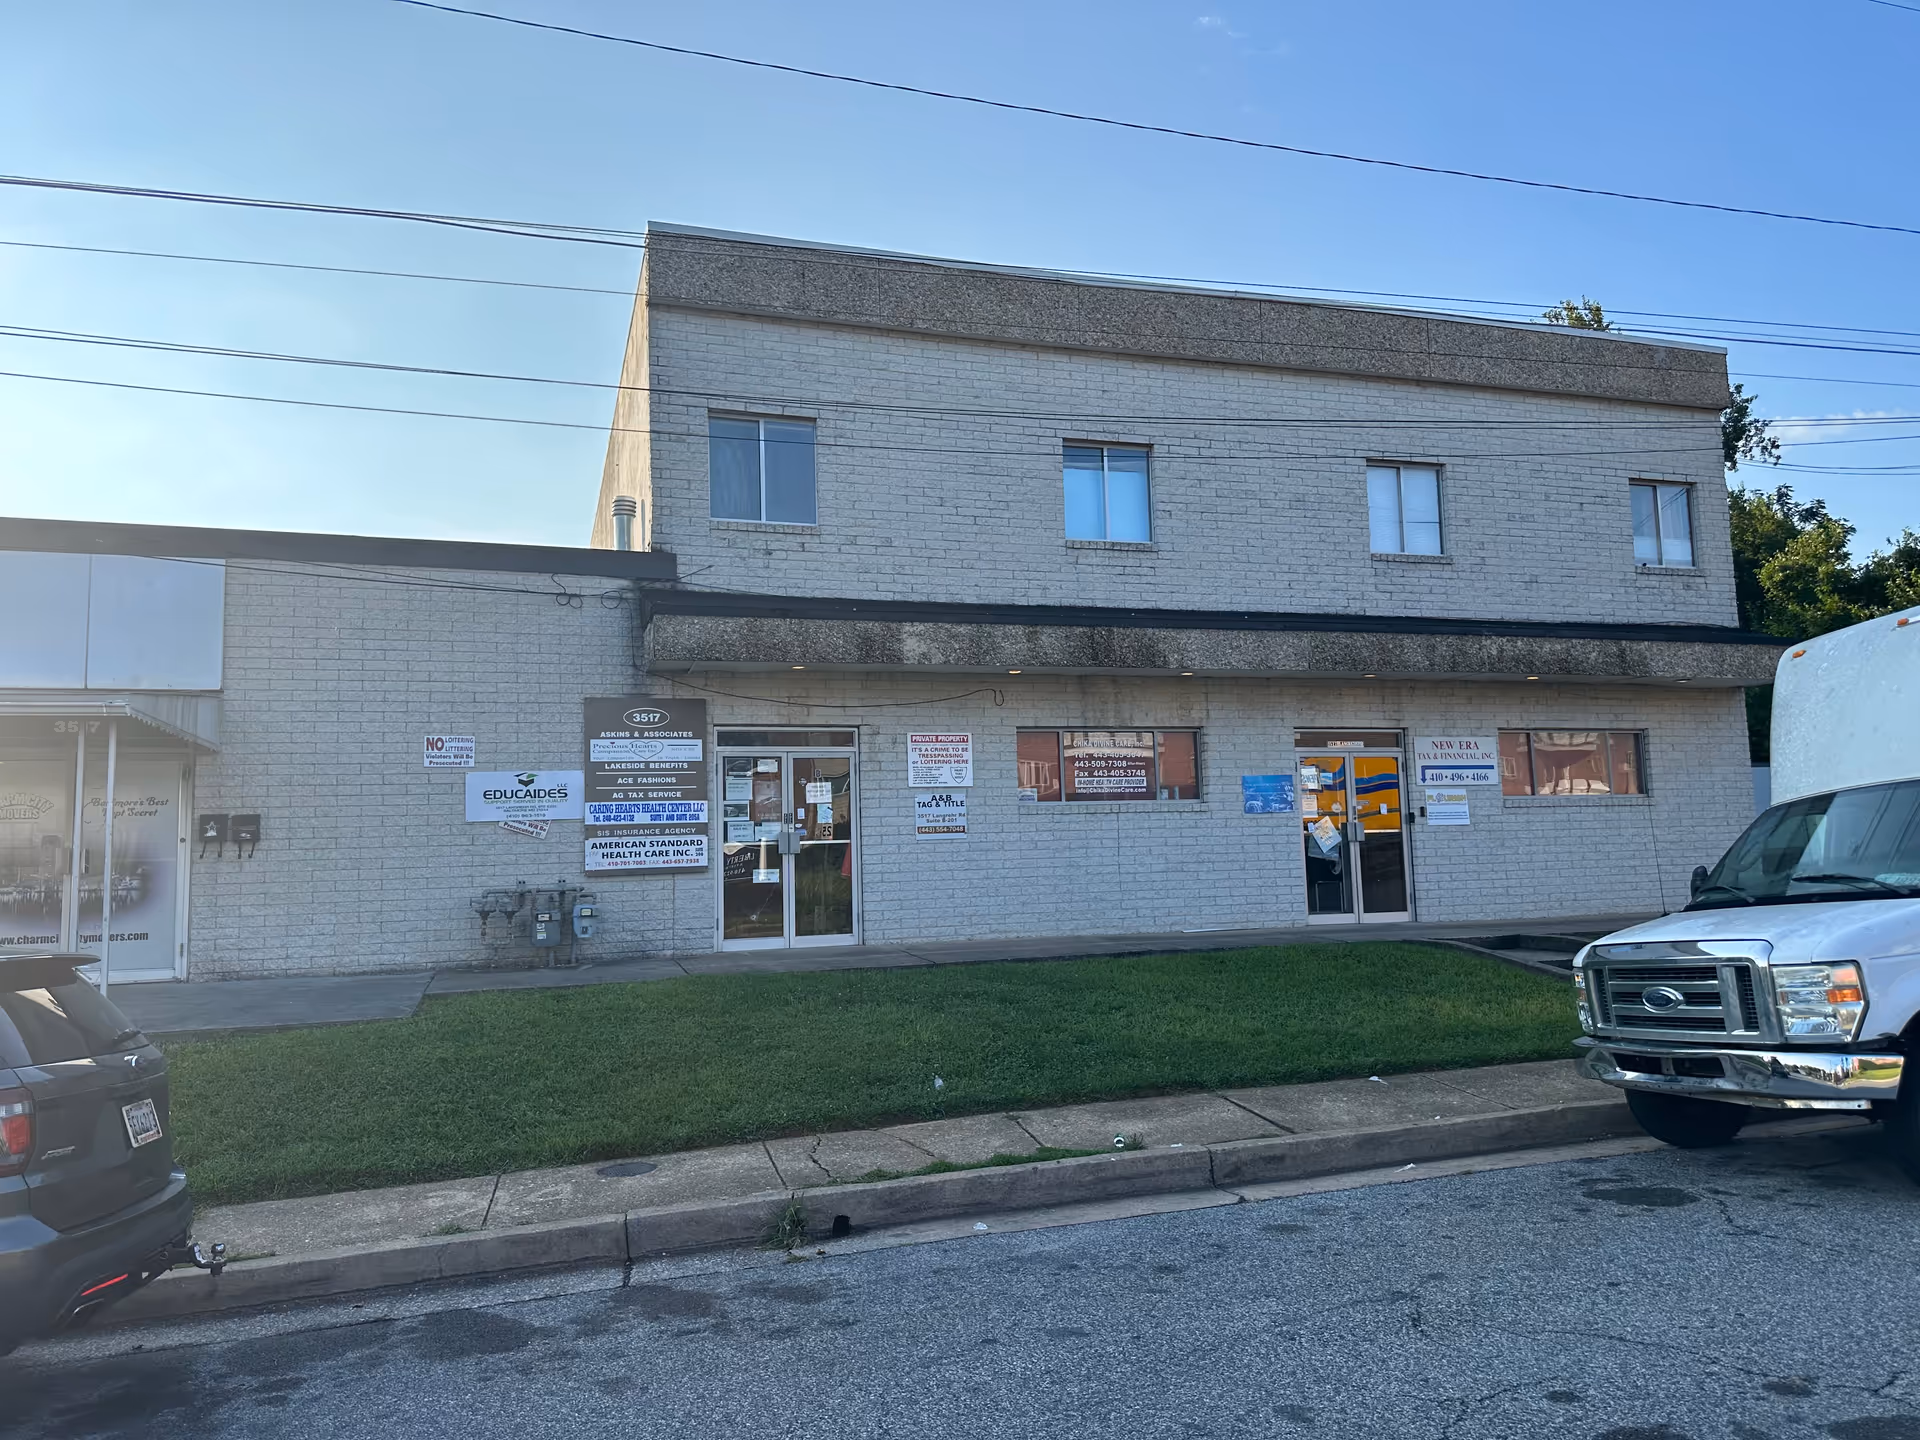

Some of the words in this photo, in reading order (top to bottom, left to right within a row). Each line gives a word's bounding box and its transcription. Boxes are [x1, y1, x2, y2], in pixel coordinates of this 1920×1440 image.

[632, 713, 660, 722] 3517
[54, 721, 100, 732] 357
[426, 737, 445, 751] NO
[1073, 740, 1092, 748] CHIKA
[1093, 740, 1115, 748] DIVINE
[1431, 740, 1455, 750] NEW
[1458, 740, 1480, 750] ERA
[1417, 752, 1431, 760] TAX
[1433, 752, 1438, 760] &
[1440, 752, 1480, 760] FINANCIAL,
[1074, 760, 1127, 768] 443-509-7308
[1093, 769, 1146, 777] 443-405-3748
[1430, 773, 1443, 782] 410
[1450, 773, 1465, 782] 496
[1471, 772, 1489, 782] 4166
[483, 788, 568, 800] EDUCAIDES
[589, 804, 614, 815] CARING
[615, 803, 641, 814] HEARTS
[641, 803, 666, 813] HEALTH
[667, 802, 692, 812] CENTER
[693, 802, 705, 812] LLC
[602, 814, 635, 823] 240-423-4132
[665, 813, 675, 821] AND
[676, 813, 688, 821] SUITE
[591, 840, 646, 850] AMERICAN
[649, 839, 703, 848] STANDARD
[602, 850, 641, 859] HEALTH
[644, 849, 670, 857] CARE
[673, 848, 693, 857] INC.
